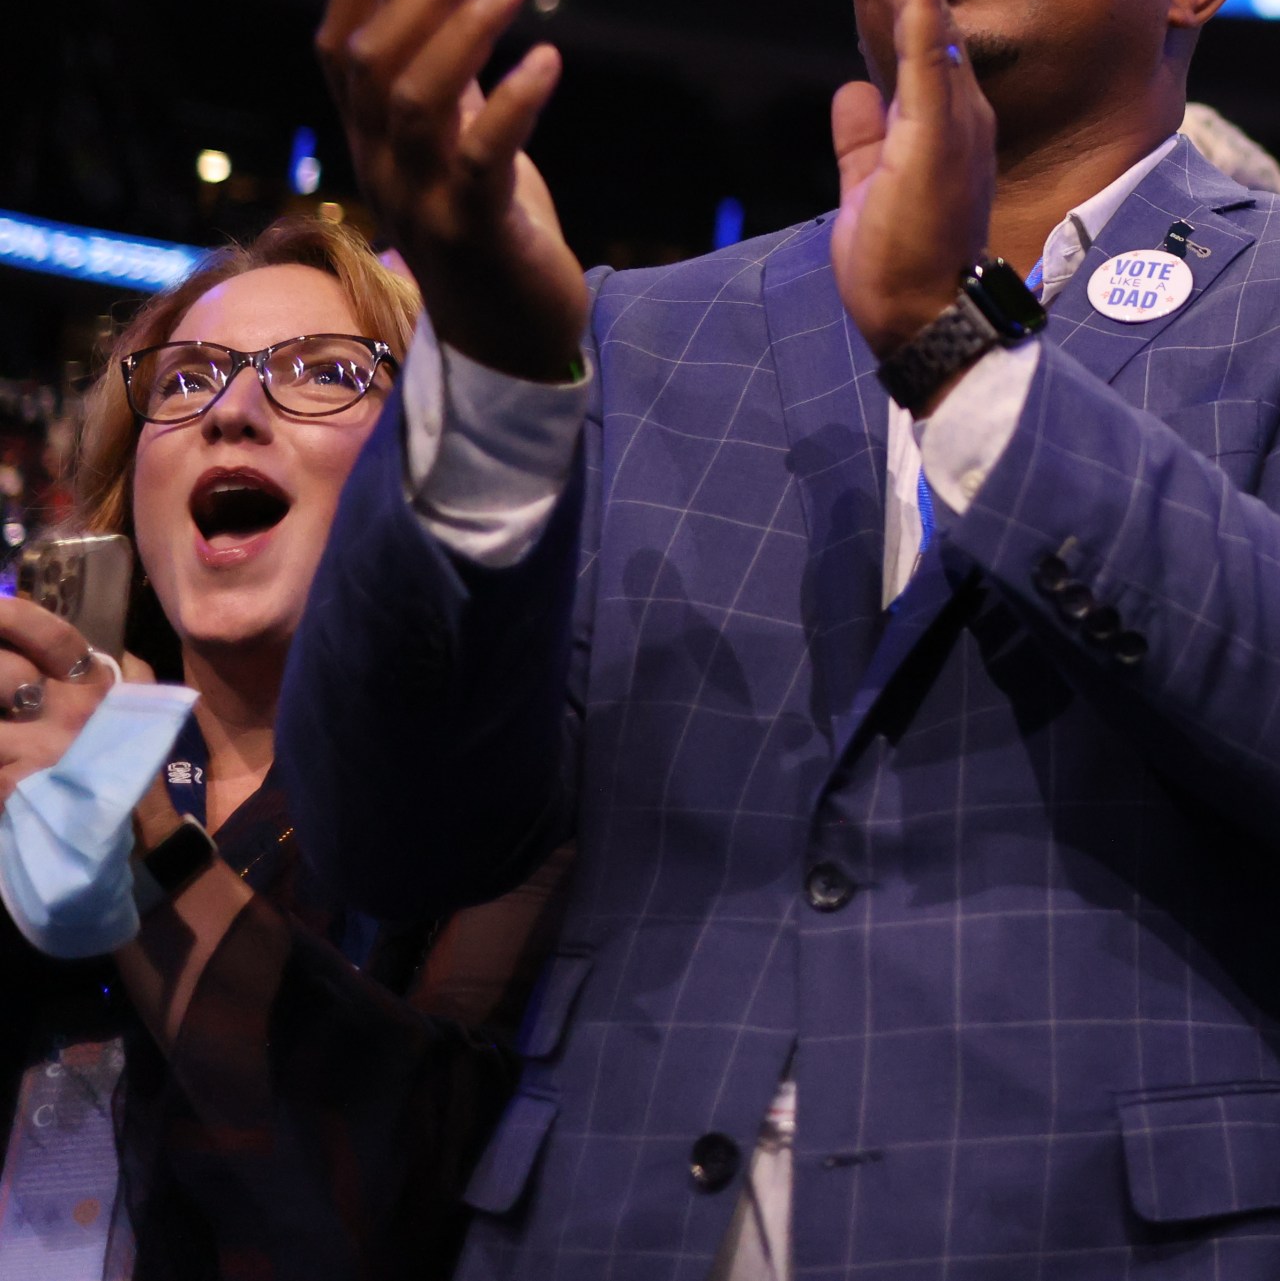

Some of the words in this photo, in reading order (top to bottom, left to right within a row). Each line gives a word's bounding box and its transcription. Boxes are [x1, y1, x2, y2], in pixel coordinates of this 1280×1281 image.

[1115, 259, 1174, 280] VOTE
[1110, 277, 1141, 288] LIKE
[1156, 282, 1166, 291] A
[1107, 287, 1158, 308] DAD
